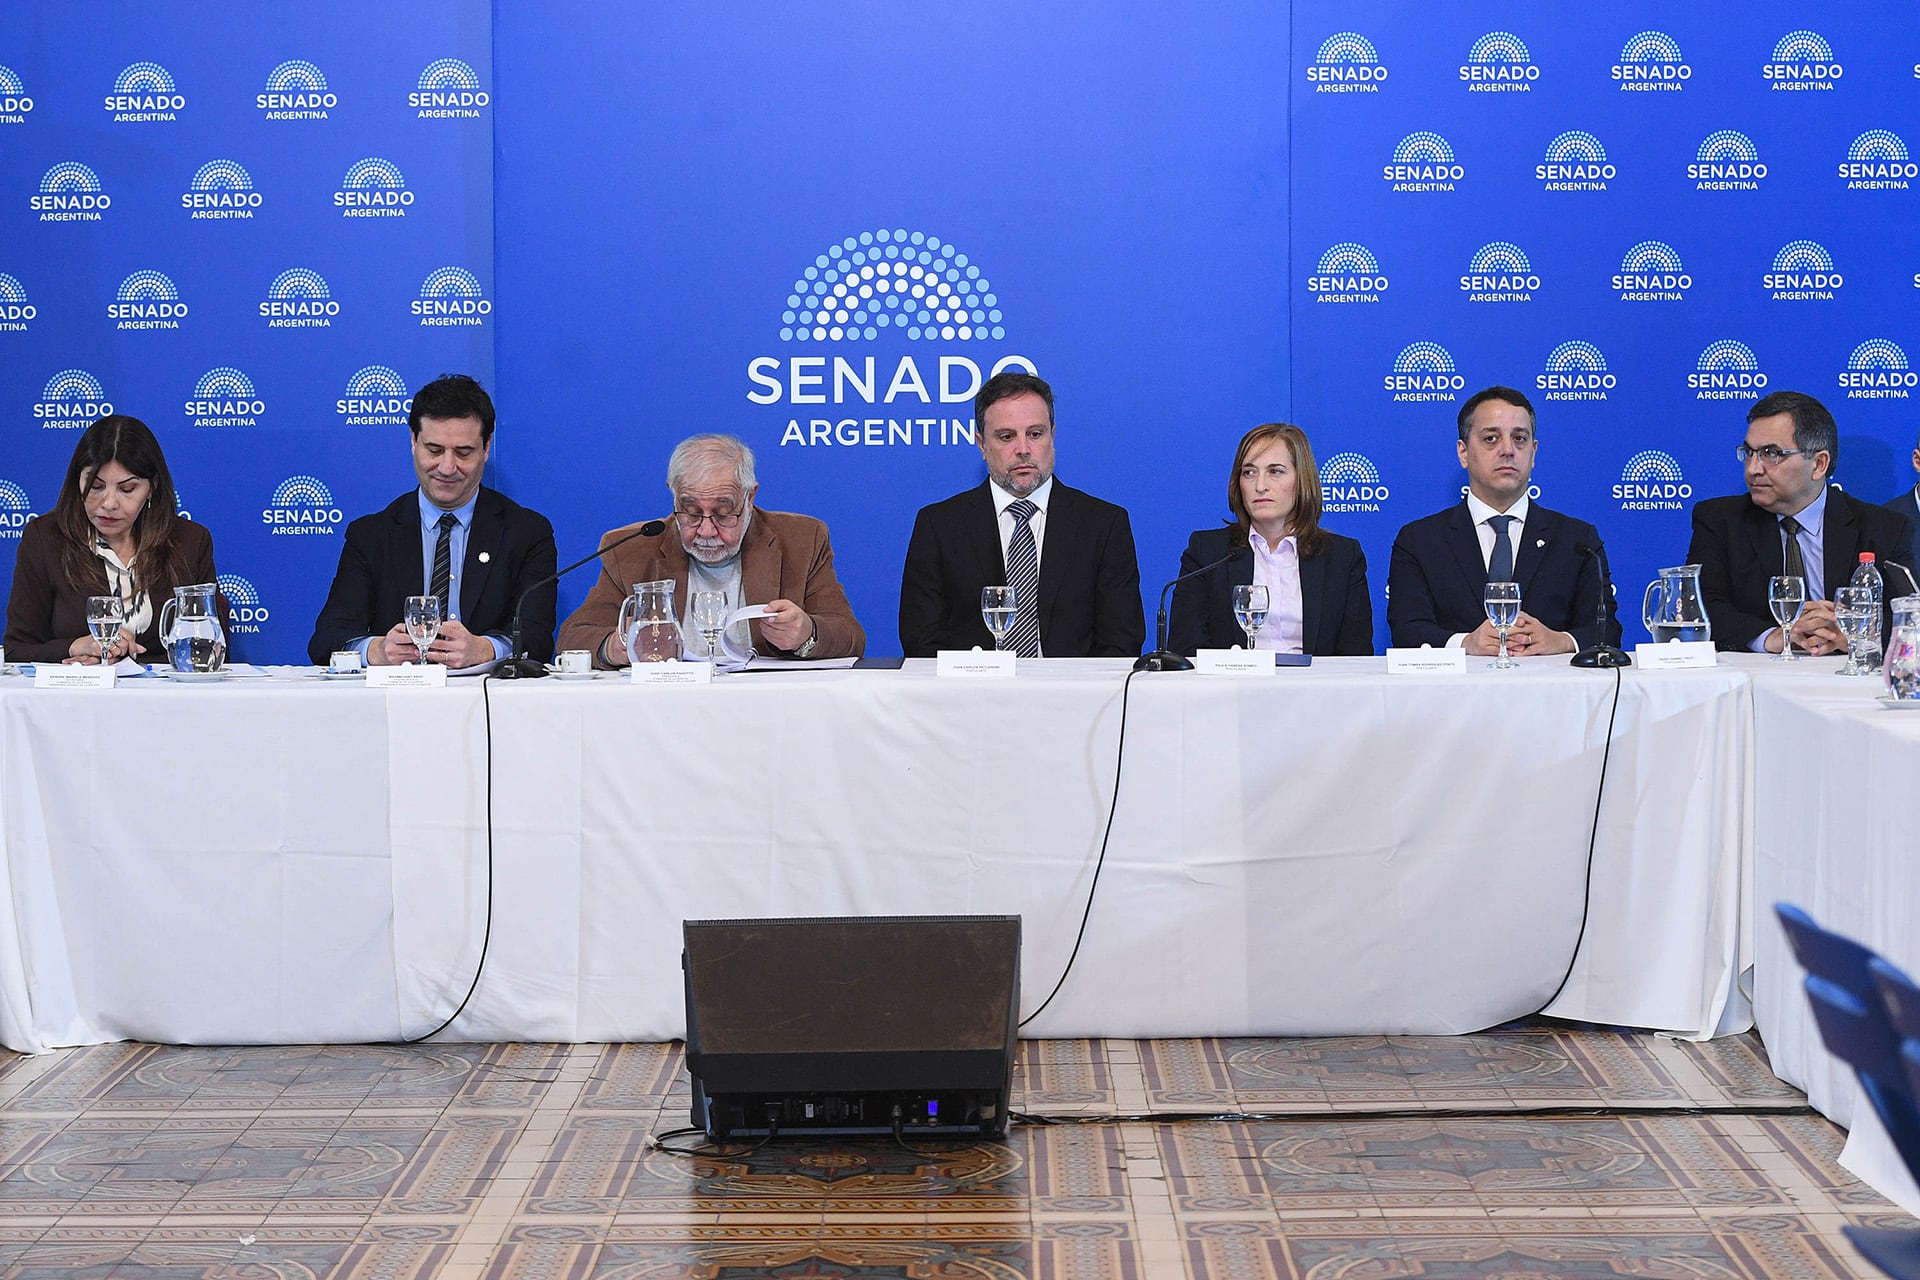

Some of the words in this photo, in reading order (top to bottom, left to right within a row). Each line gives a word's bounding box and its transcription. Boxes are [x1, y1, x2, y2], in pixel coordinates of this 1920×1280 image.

[1306, 66, 1388, 82] SENADO
[1459, 65, 1540, 81] SENADO
[1611, 64, 1692, 80] SENADO
[1762, 64, 1843, 79] SENADO
[1316, 83, 1379, 93] ARGENTINA
[1468, 83, 1531, 92] ARGENTINA
[1620, 82, 1683, 92] ARGENTINA
[1771, 81, 1834, 91] ARGENTINA
[104, 95, 186, 111] SENADO
[256, 93, 338, 109] SENADO
[408, 92, 490, 107] SENADO
[113, 112, 177, 122] ARGENTINA
[265, 110, 328, 120] ARGENTINA
[417, 109, 480, 118] ARGENTINA
[1383, 165, 1465, 181] SENADO
[1535, 164, 1616, 180] SENADO
[1687, 163, 1768, 179] SENADO
[1838, 163, 1919, 178] SENADO
[1392, 182, 1455, 192] ARGENTINA
[1544, 182, 1607, 191] ARGENTINA
[1696, 181, 1759, 191] ARGENTINA
[1847, 180, 1909, 190] ARGENTINA
[30, 194, 111, 210] SENADO
[181, 192, 263, 208] SENADO
[333, 191, 415, 206] SENADO
[39, 212, 102, 222] ARGENTINA
[191, 210, 254, 219] ARGENTINA
[343, 208, 406, 218] ARGENTINA
[1307, 276, 1389, 292] SENADO
[1460, 275, 1541, 291] SENADO
[1612, 274, 1692, 290] SENADO
[1763, 273, 1843, 289] SENADO
[1317, 294, 1379, 303] ARGENTINA
[1469, 293, 1531, 302] ARGENTINA
[1621, 292, 1683, 301] ARGENTINA
[1772, 291, 1834, 301] ARGENTINA
[0, 305, 37, 320] ADO
[107, 303, 188, 319] SENADO
[259, 301, 340, 317] SENADO
[411, 300, 492, 315] SENADO
[116, 320, 179, 330] ARGENTINA
[268, 318, 331, 328] ARGENTINA
[420, 317, 483, 326] ARGENTINA
[1384, 375, 1465, 391] SENADO
[1536, 374, 1617, 389] SENADO
[1687, 373, 1768, 388] SENADO
[1838, 372, 1918, 387] SENADO
[1393, 392, 1456, 402] ARGENTINA
[1545, 391, 1608, 401] ARGENTINA
[1696, 390, 1759, 400] ARGENTINA
[1847, 389, 1909, 399] ARGENTINA
[33, 402, 114, 417] SENADO
[184, 400, 266, 416] SENADO
[42, 419, 97, 430] ARGENTI
[194, 417, 256, 427] ARGENTINA
[345, 416, 408, 426] ARGENTINA
[780, 418, 976, 447] ARGENTIN
[1320, 485, 1390, 501] ENADO
[1612, 484, 1693, 499] SENADO
[1621, 501, 1683, 510] ARGENTINA
[262, 508, 343, 524] SENADO
[271, 526, 334, 535] ARGENTINA
[228, 607, 269, 622] ADO
[228, 624, 260, 634] NTINA
